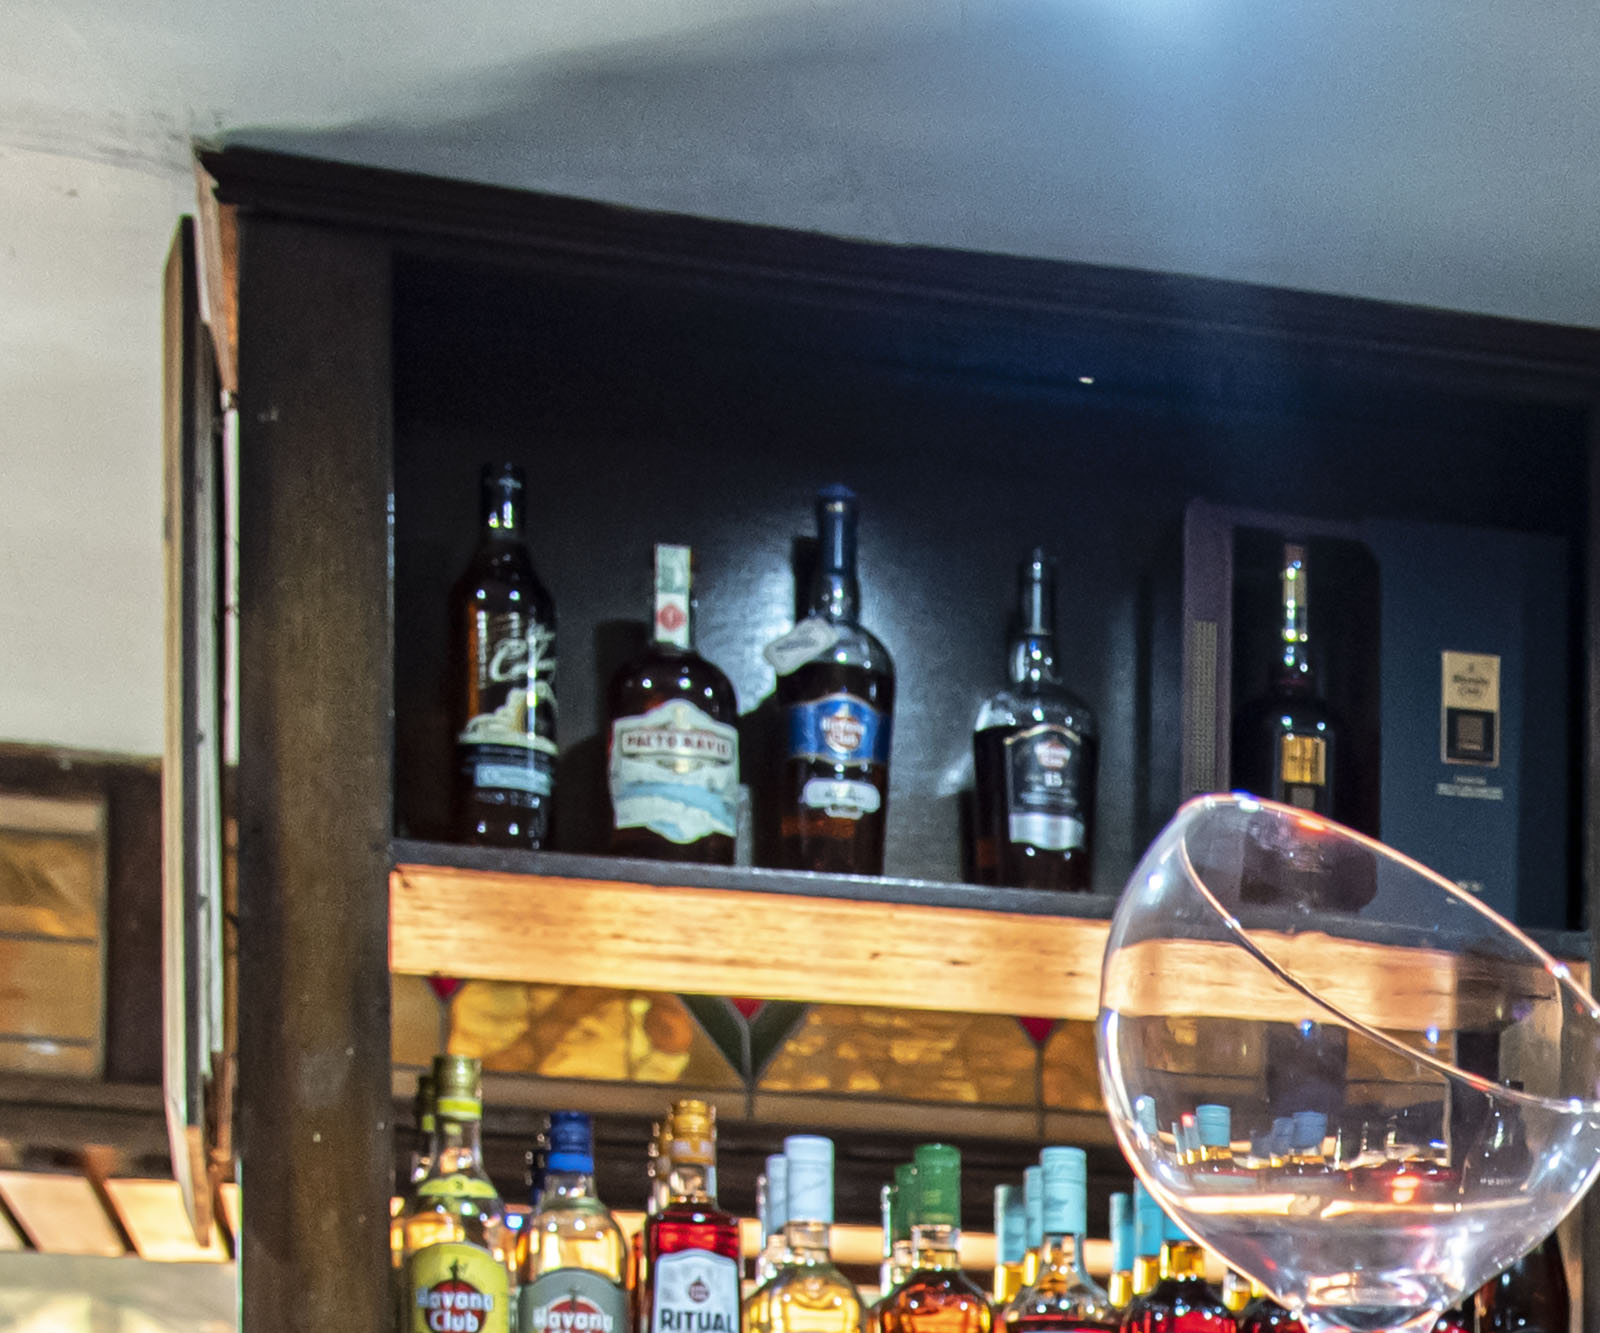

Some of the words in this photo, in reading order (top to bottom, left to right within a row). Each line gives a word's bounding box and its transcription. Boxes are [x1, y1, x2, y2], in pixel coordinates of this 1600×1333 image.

[416, 1286, 494, 1312] Havana
[429, 1309, 479, 1333] Club
[532, 1306, 613, 1332] Havana
